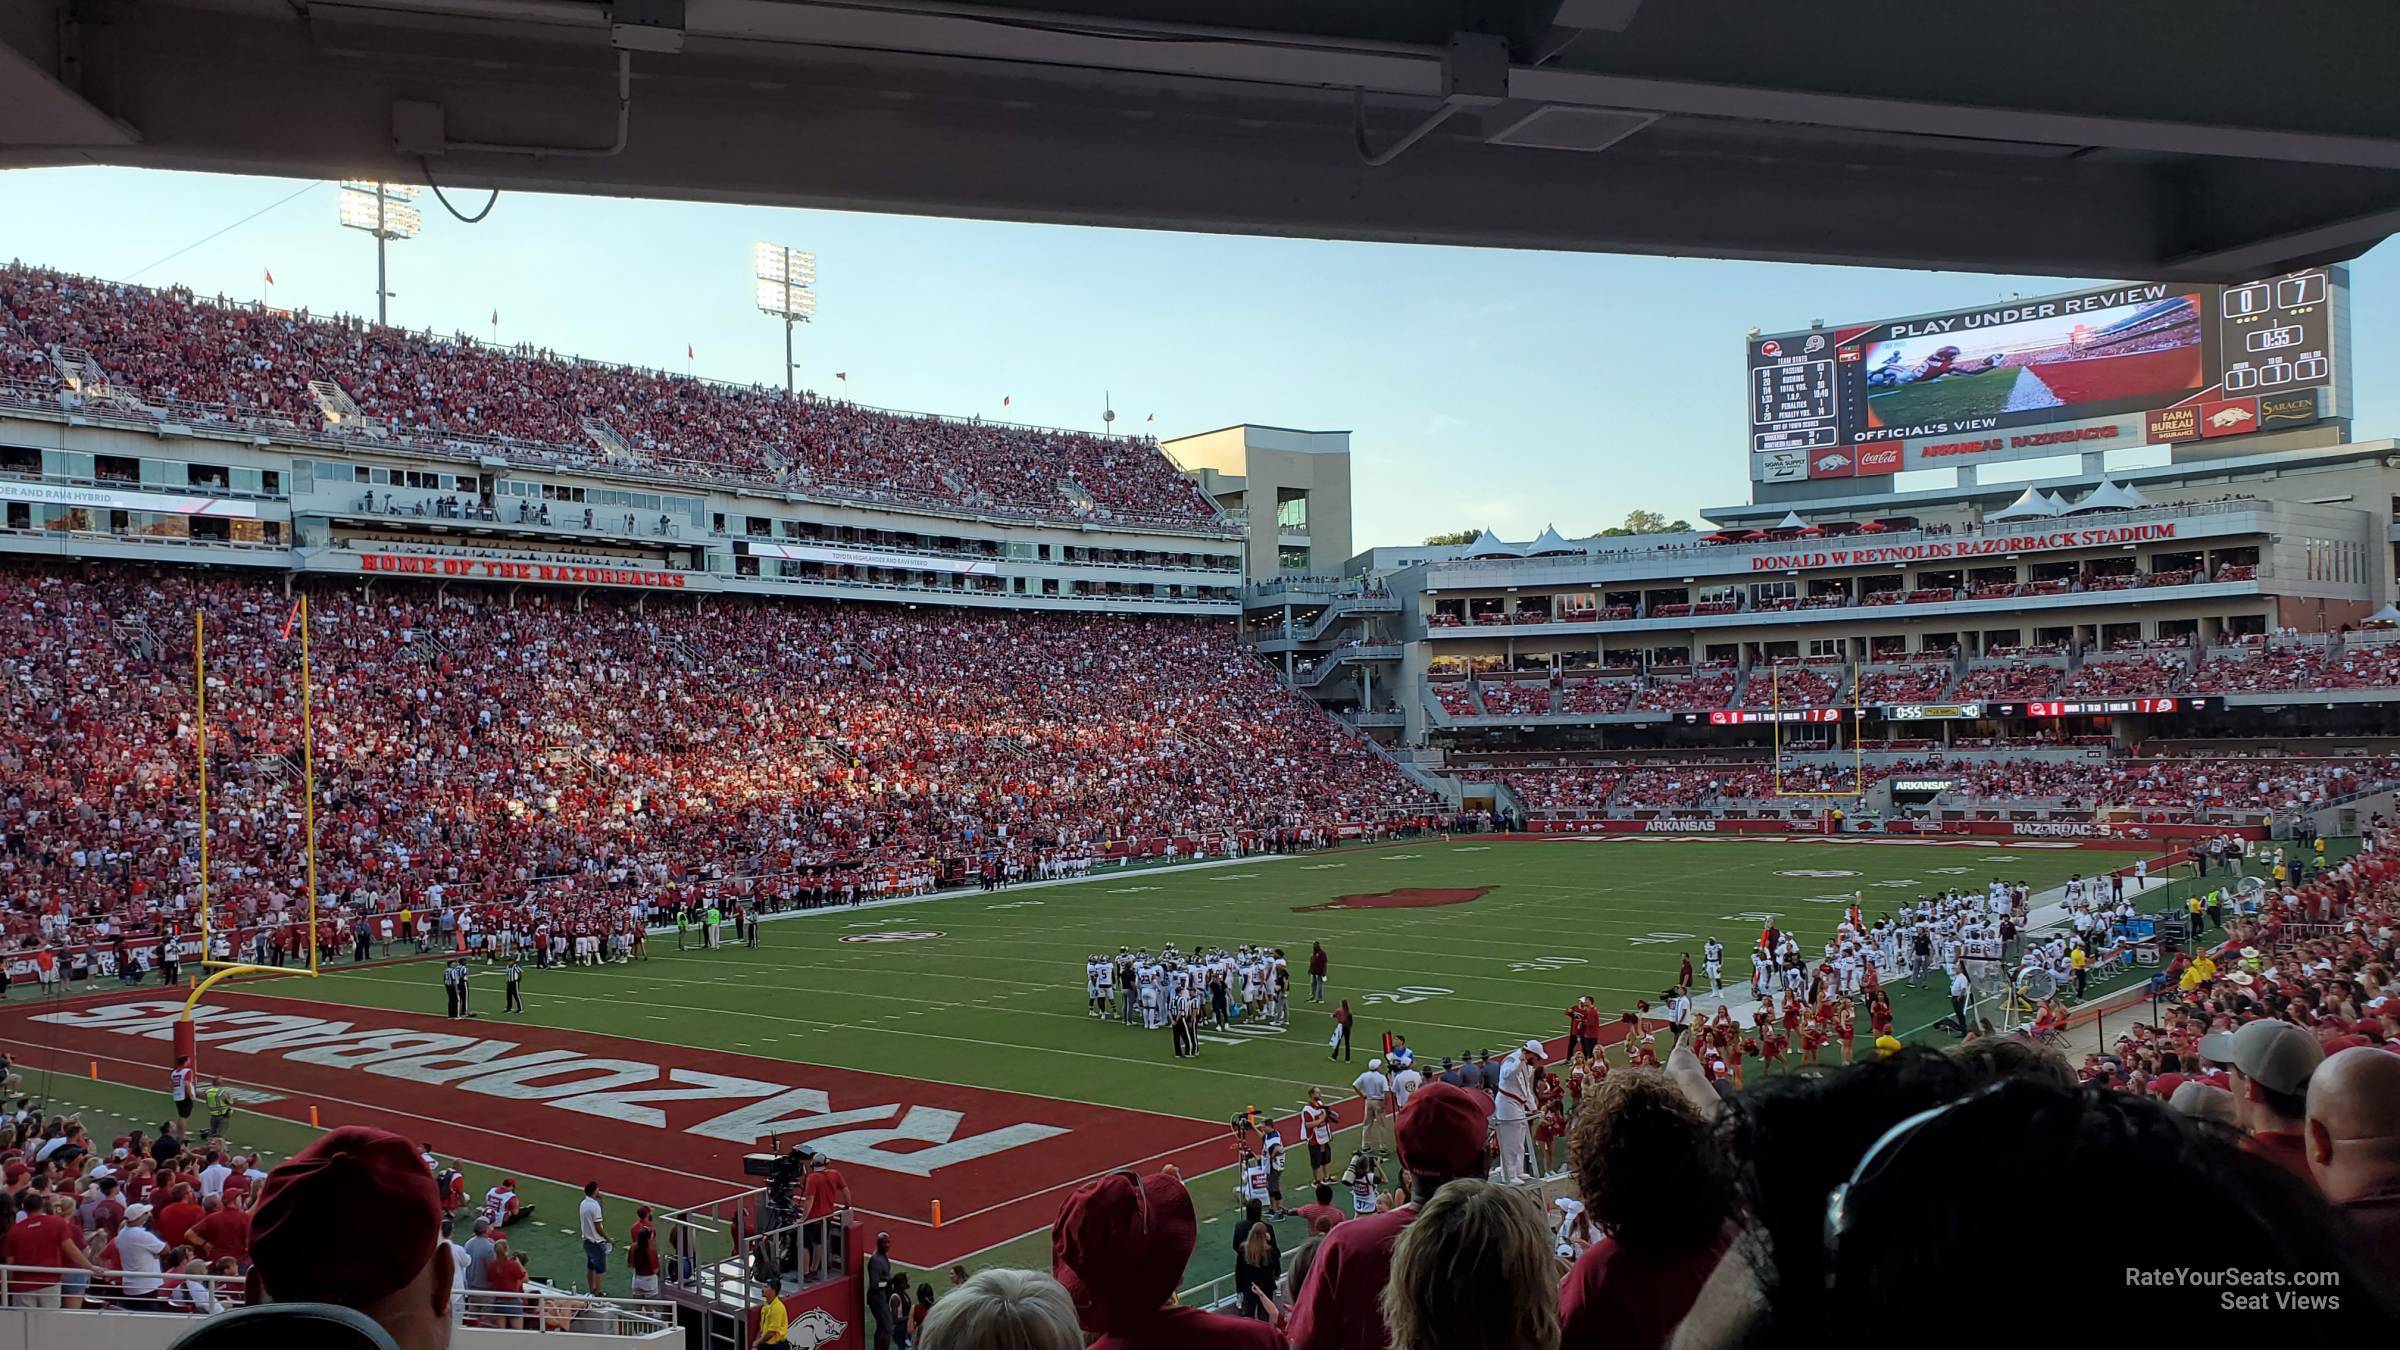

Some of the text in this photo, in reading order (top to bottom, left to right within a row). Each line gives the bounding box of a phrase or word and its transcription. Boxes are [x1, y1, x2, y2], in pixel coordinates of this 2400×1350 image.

[2294, 279, 2307, 304] 7
[2240, 289, 2253, 313] 0
[1890, 283, 2167, 339] PLAY UNDER REVIEW
[2262, 328, 2290, 348] 0:55
[2162, 409, 2193, 421] FARM
[2262, 399, 2313, 416] SARACEN
[1853, 417, 1997, 442] OFFICIAL'S VIEW
[2151, 419, 2194, 432] BUREAU
[1920, 424, 2120, 459] ARKANSAS RAZORBACKS
[2158, 430, 2194, 439] INSURANCE
[1784, 459, 1806, 467] SUPPLY
[18, 488, 44, 498] AND
[73, 492, 112, 502] HYBRID
[1751, 522, 2177, 571] DONALD W REYNOLDS RAZORBACK STADIUM
[360, 554, 686, 588] HOME OF THE RAZORBACKS
[1896, 706, 1922, 719] 0:55
[1962, 705, 1978, 717] 40
[2051, 702, 2058, 716] 0
[2143, 700, 2150, 713] 7
[1731, 712, 1738, 724] 0
[1813, 709, 1819, 722] 7
[1895, 780, 1953, 791] ARKANSAS
[1644, 820, 1717, 833] ARKANSAS
[2012, 822, 2112, 836] RAZORBACS
[575, 923, 587, 934] 55
[1506, 955, 1589, 973] 30
[1360, 985, 1456, 1007] 20
[28, 1000, 1072, 1176] RAZORBACKS
